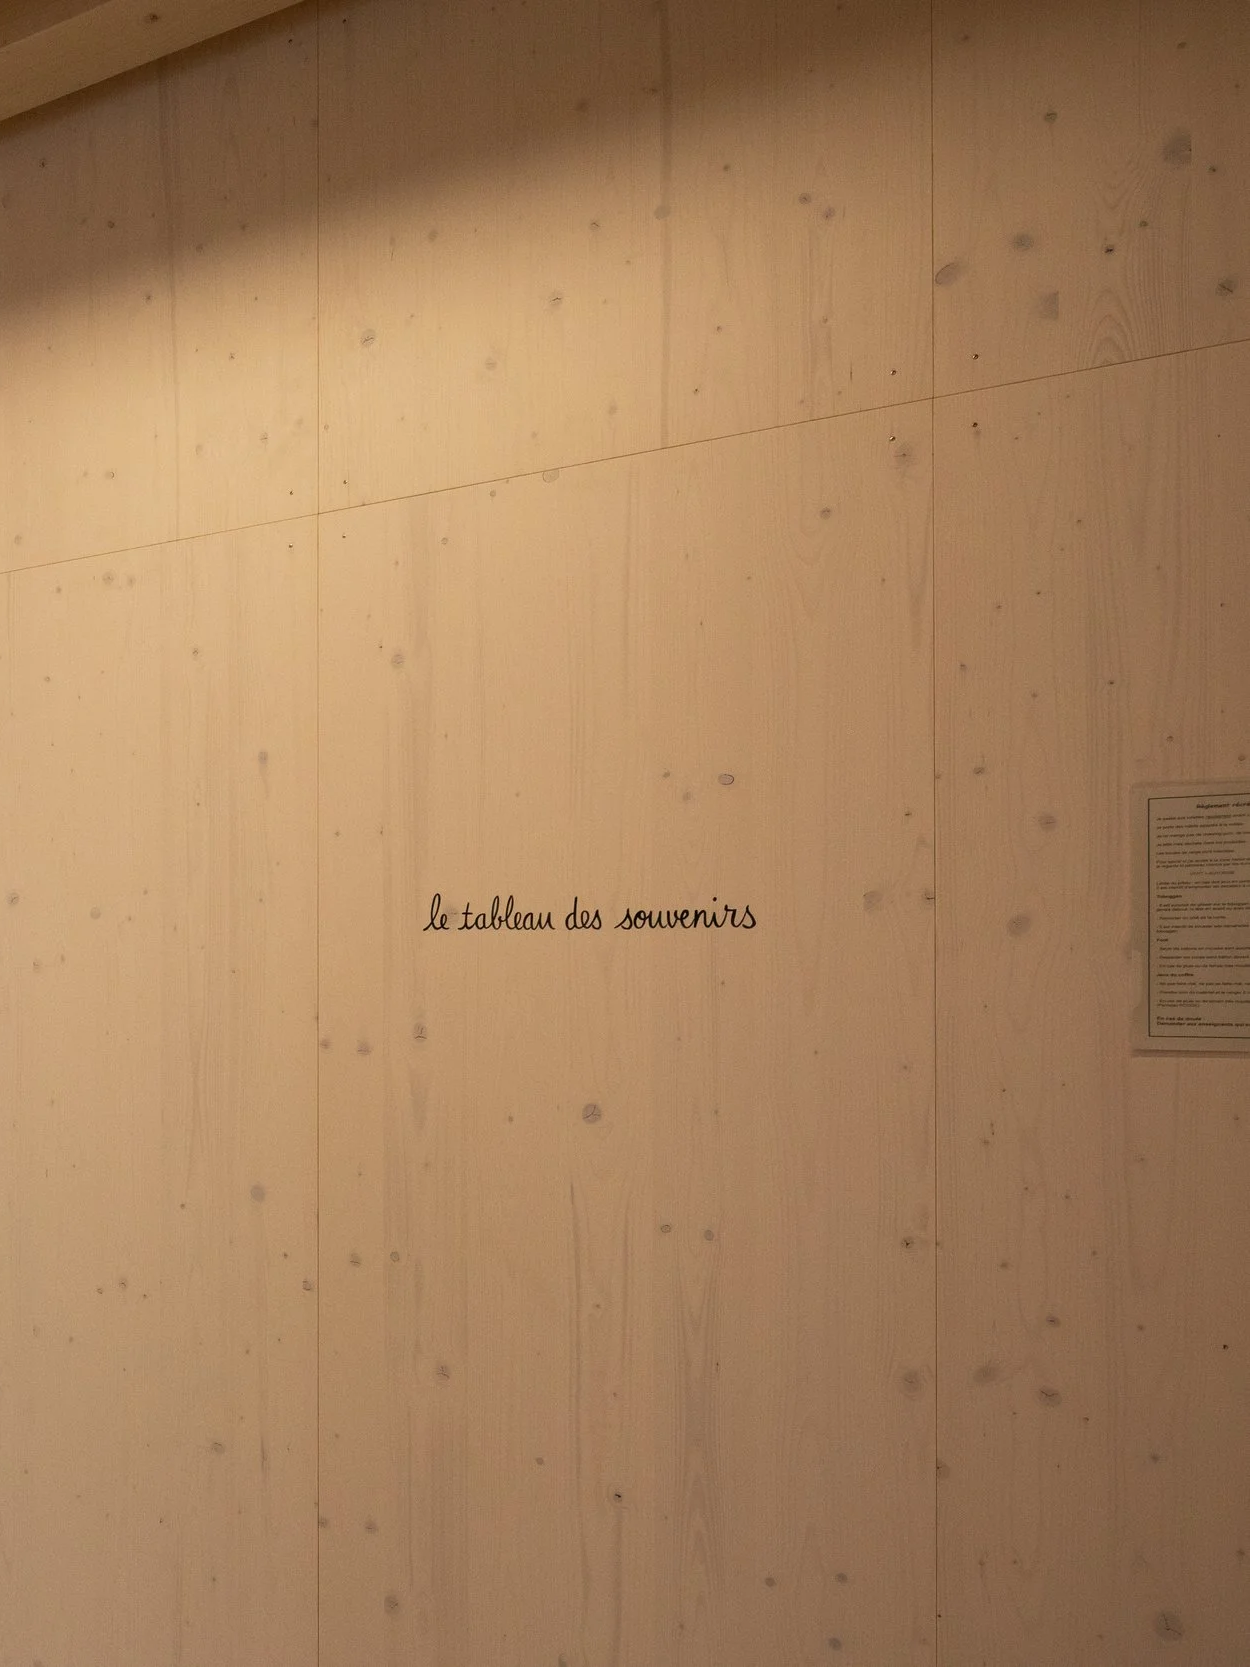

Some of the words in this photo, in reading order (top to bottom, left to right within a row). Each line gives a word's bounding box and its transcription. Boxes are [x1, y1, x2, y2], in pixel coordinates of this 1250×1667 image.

[423, 893, 450, 931] le
[457, 894, 556, 931] tableau
[565, 896, 602, 931] des
[614, 896, 757, 931] souvenirs
